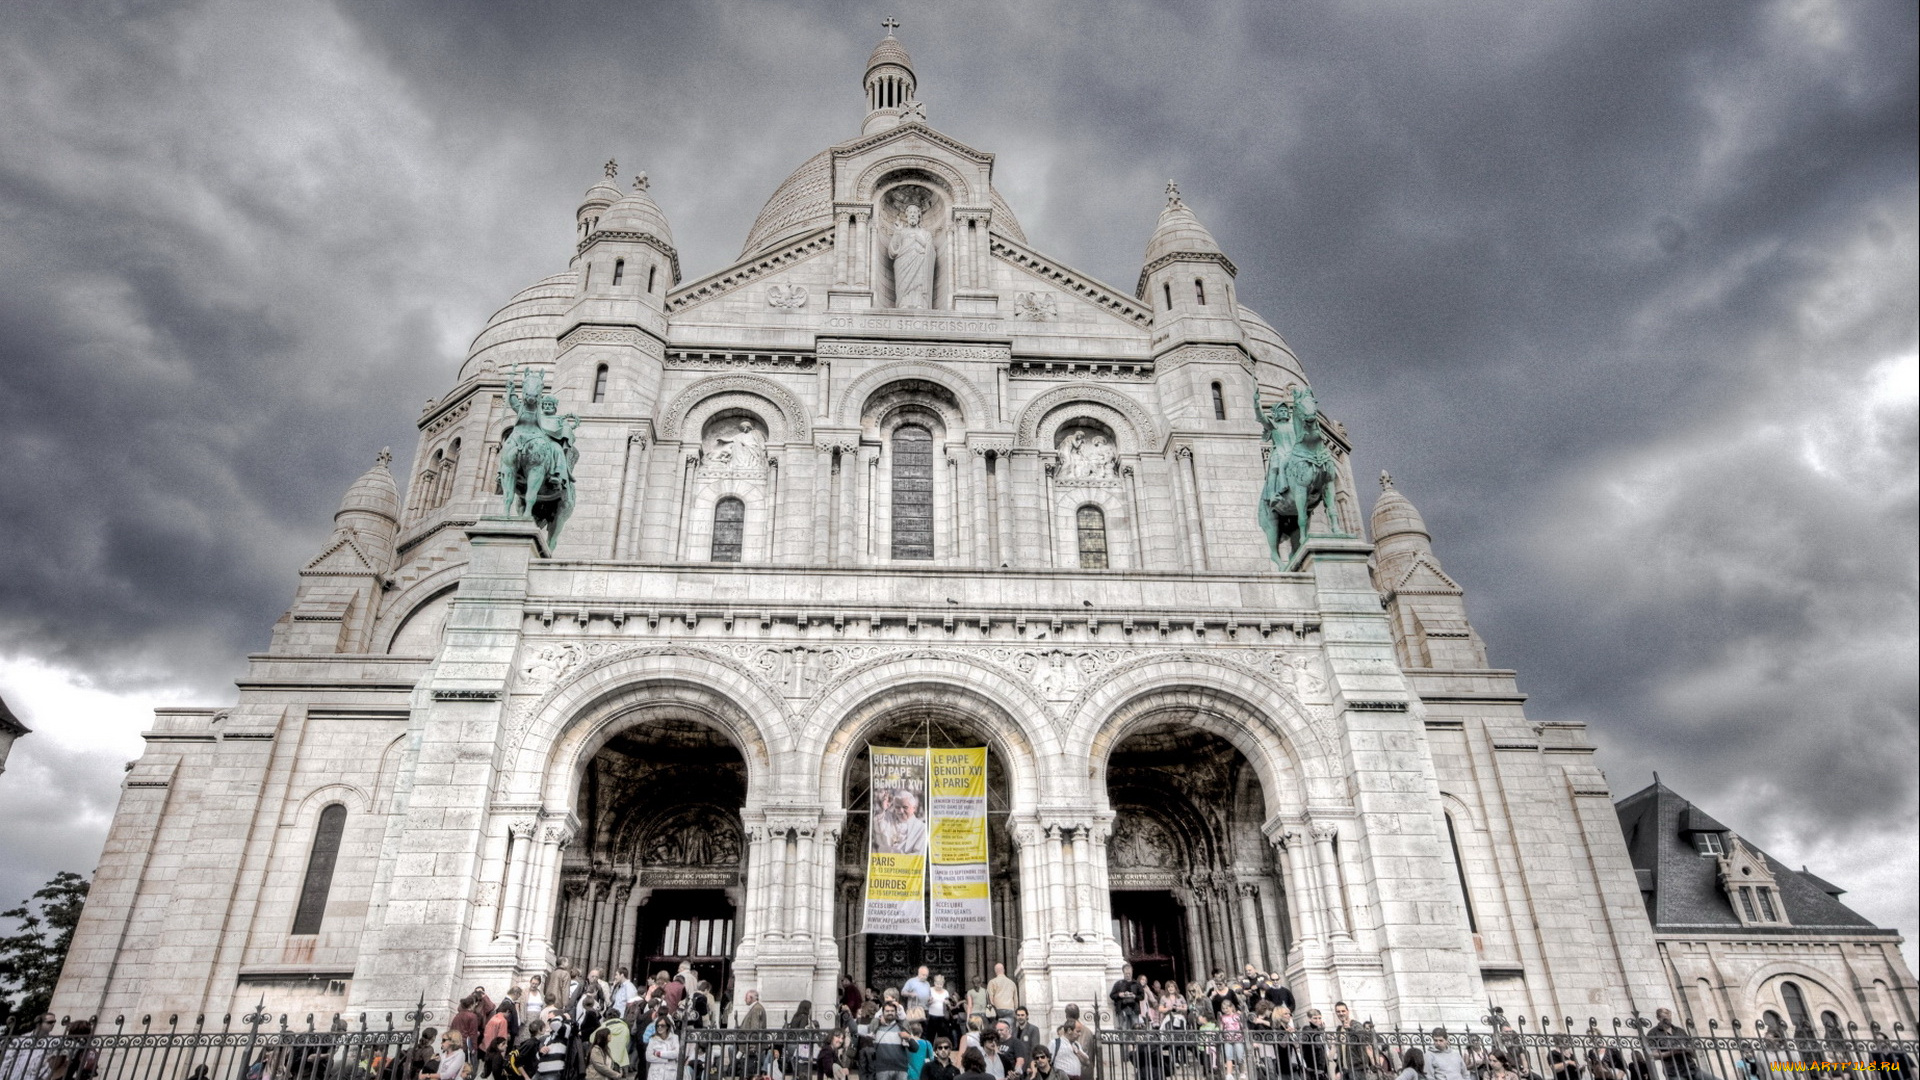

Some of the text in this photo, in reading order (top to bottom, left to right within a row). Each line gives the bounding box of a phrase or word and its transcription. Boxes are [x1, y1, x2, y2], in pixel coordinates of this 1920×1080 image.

[874, 754, 925, 766] BIENVENUE
[933, 754, 970, 764] LE PAPE
[874, 766, 912, 777] AU PAPE
[969, 765, 983, 776] XVI
[908, 779, 923, 791] XVI
[943, 778, 970, 788] PARIS
[871, 857, 895, 867] PARIS
[870, 879, 907, 890] LOURDES
